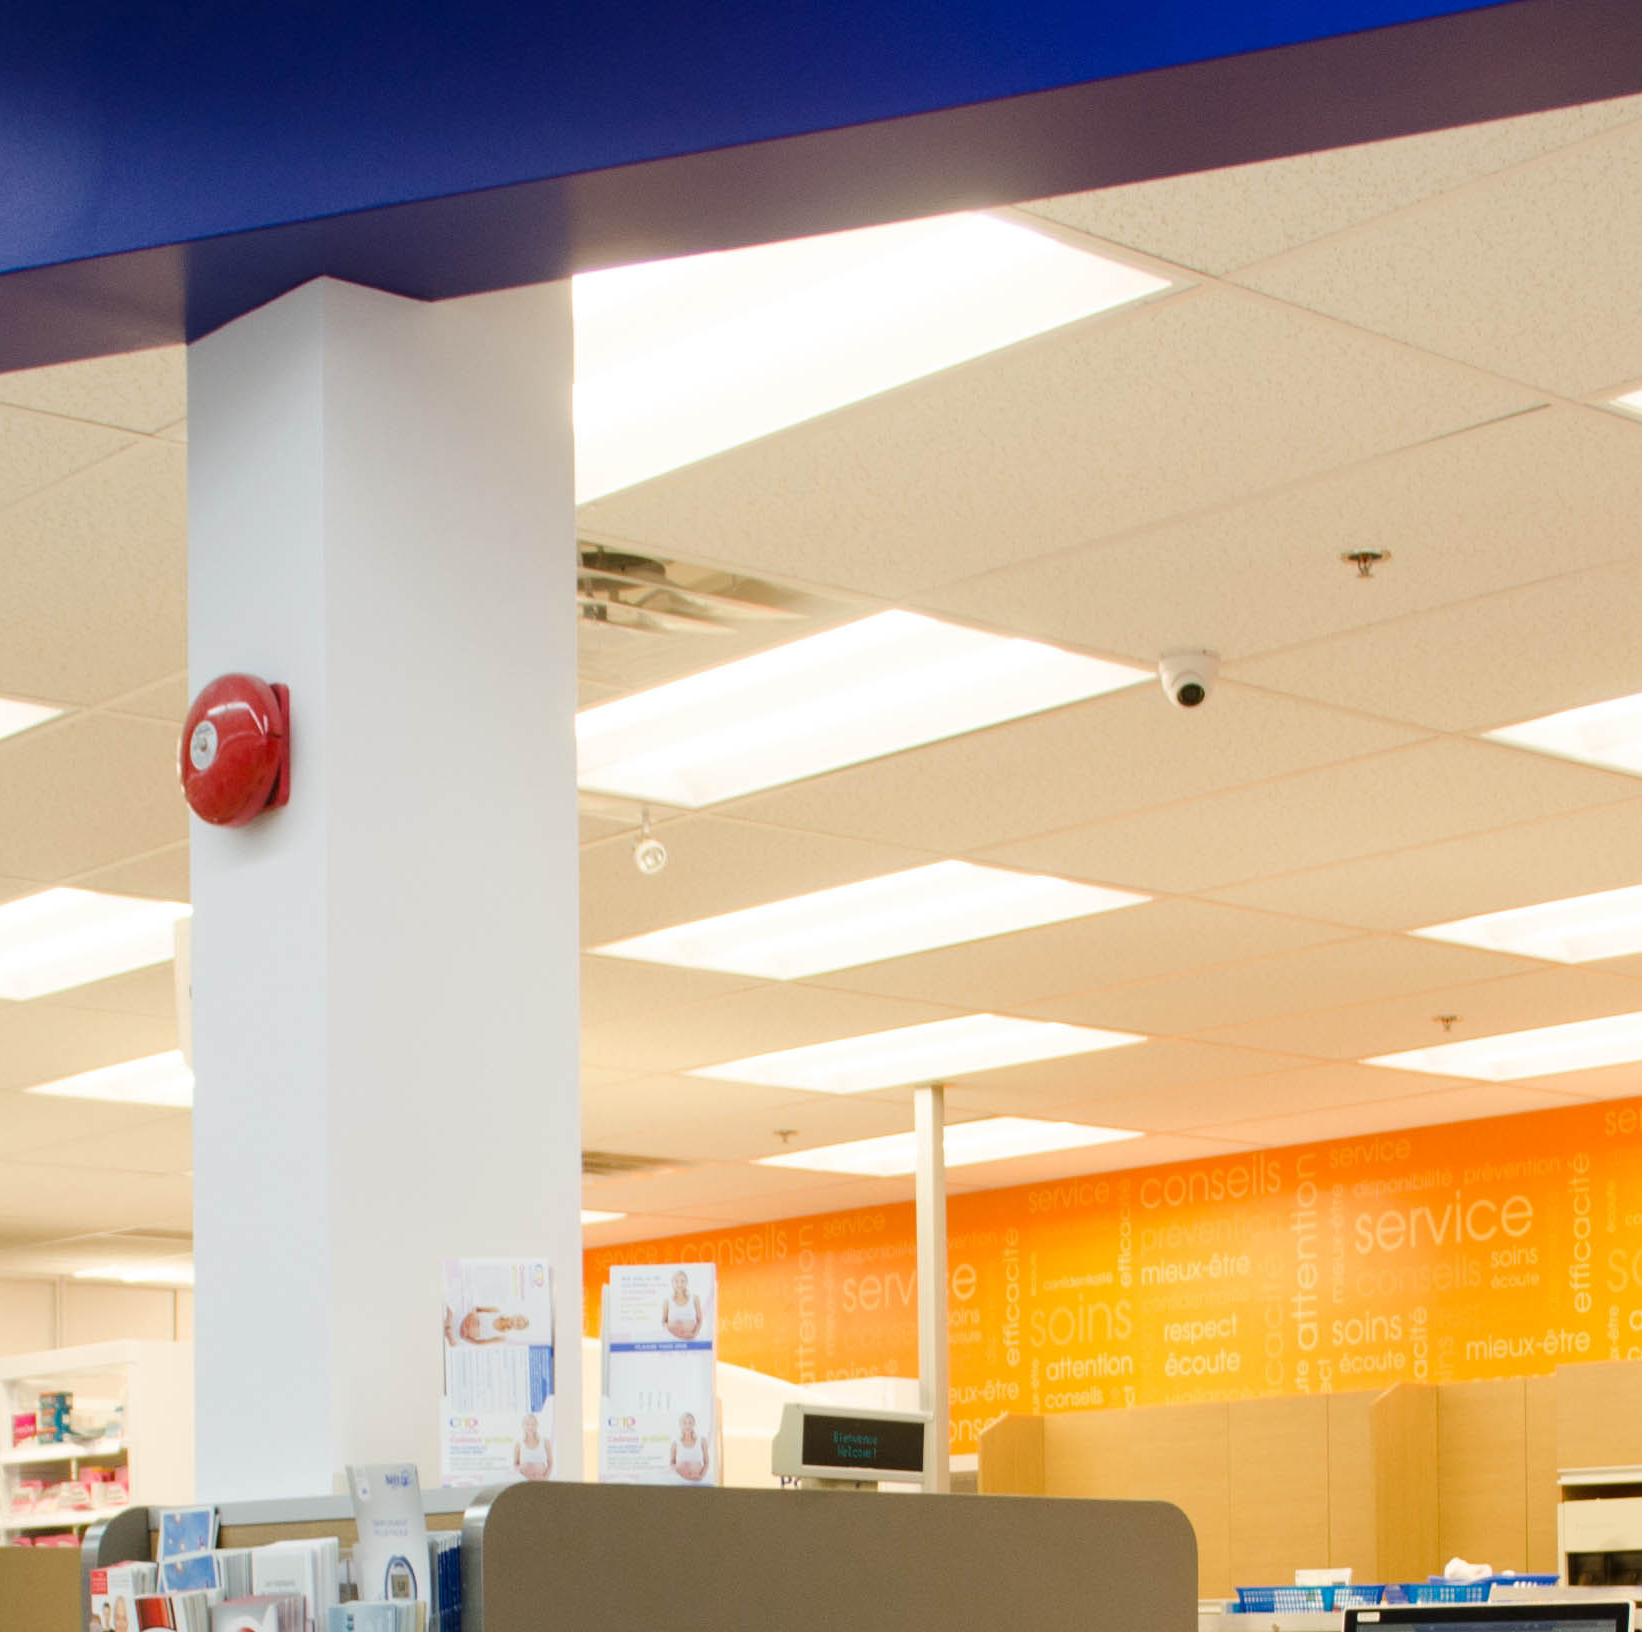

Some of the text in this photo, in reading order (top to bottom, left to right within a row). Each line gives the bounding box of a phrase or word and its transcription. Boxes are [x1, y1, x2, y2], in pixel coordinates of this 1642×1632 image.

[1329, 1137, 1412, 1169] service
[1140, 1154, 1282, 1209] conseils
[1463, 1156, 1559, 1186] prévention
[1027, 1178, 1110, 1214] service
[821, 1213, 886, 1239] service
[1354, 1191, 1534, 1254] service
[1569, 1152, 1592, 1313] efficacité
[679, 1225, 788, 1267] conseils
[1291, 1153, 1318, 1351] attention
[1489, 1244, 1539, 1270] soins
[1140, 1252, 1252, 1286] mieux-être
[1490, 1271, 1540, 1290] écoute
[1001, 1226, 1021, 1368] efficacité
[1029, 1293, 1133, 1349] soins
[1163, 1313, 1238, 1344] respect
[1331, 1310, 1403, 1347] soins
[1466, 1328, 1591, 1361] mieux-être
[1045, 1352, 1134, 1382] attention
[1164, 1348, 1241, 1378] écoute
[1339, 1349, 1406, 1374] écoute
[1044, 1385, 1104, 1410] conseils
